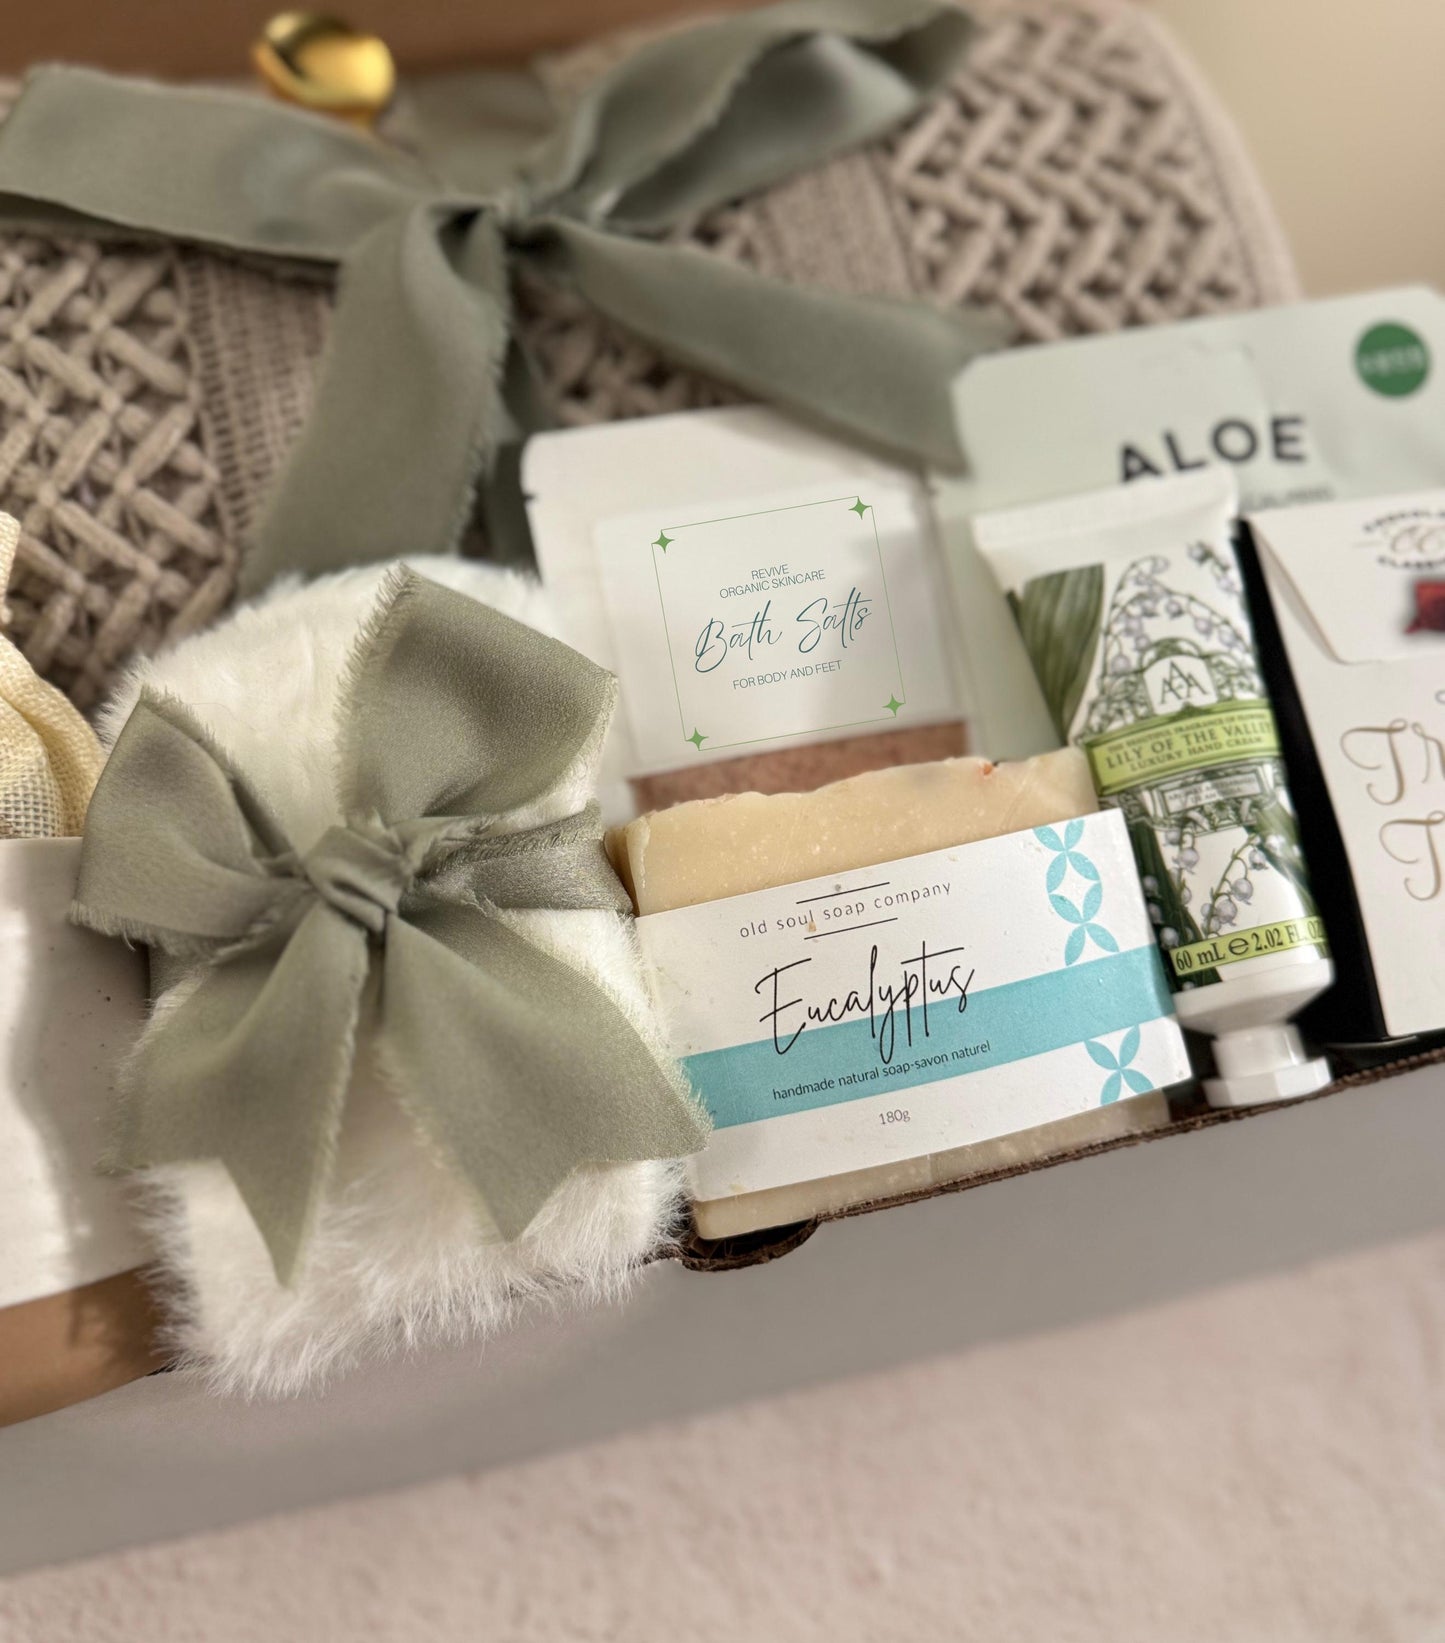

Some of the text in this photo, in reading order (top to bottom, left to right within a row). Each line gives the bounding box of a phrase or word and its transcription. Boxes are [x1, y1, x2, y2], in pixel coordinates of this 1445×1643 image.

[1118, 415, 1307, 484] ALOE
[719, 569, 826, 599] ORGANIC SKINCARE
[751, 563, 790, 581] REVIVE
[694, 586, 873, 673] Bath Salts
[732, 660, 842, 690] FOR BODY AND FEET
[1105, 745, 1143, 769] LILY
[1151, 738, 1174, 754] OF
[1183, 728, 1217, 746] THE
[1130, 736, 1262, 772] LUXURY HAND CREAM
[739, 882, 952, 938] old soul soap company
[1175, 948, 1193, 971] 60
[1195, 942, 1226, 966] mL
[1251, 927, 1284, 951] 2.02
[754, 940, 976, 1065] Eucalyptus
[772, 1039, 993, 1101] handmade natural soap-savon naturel
[878, 1108, 912, 1126] 180g
